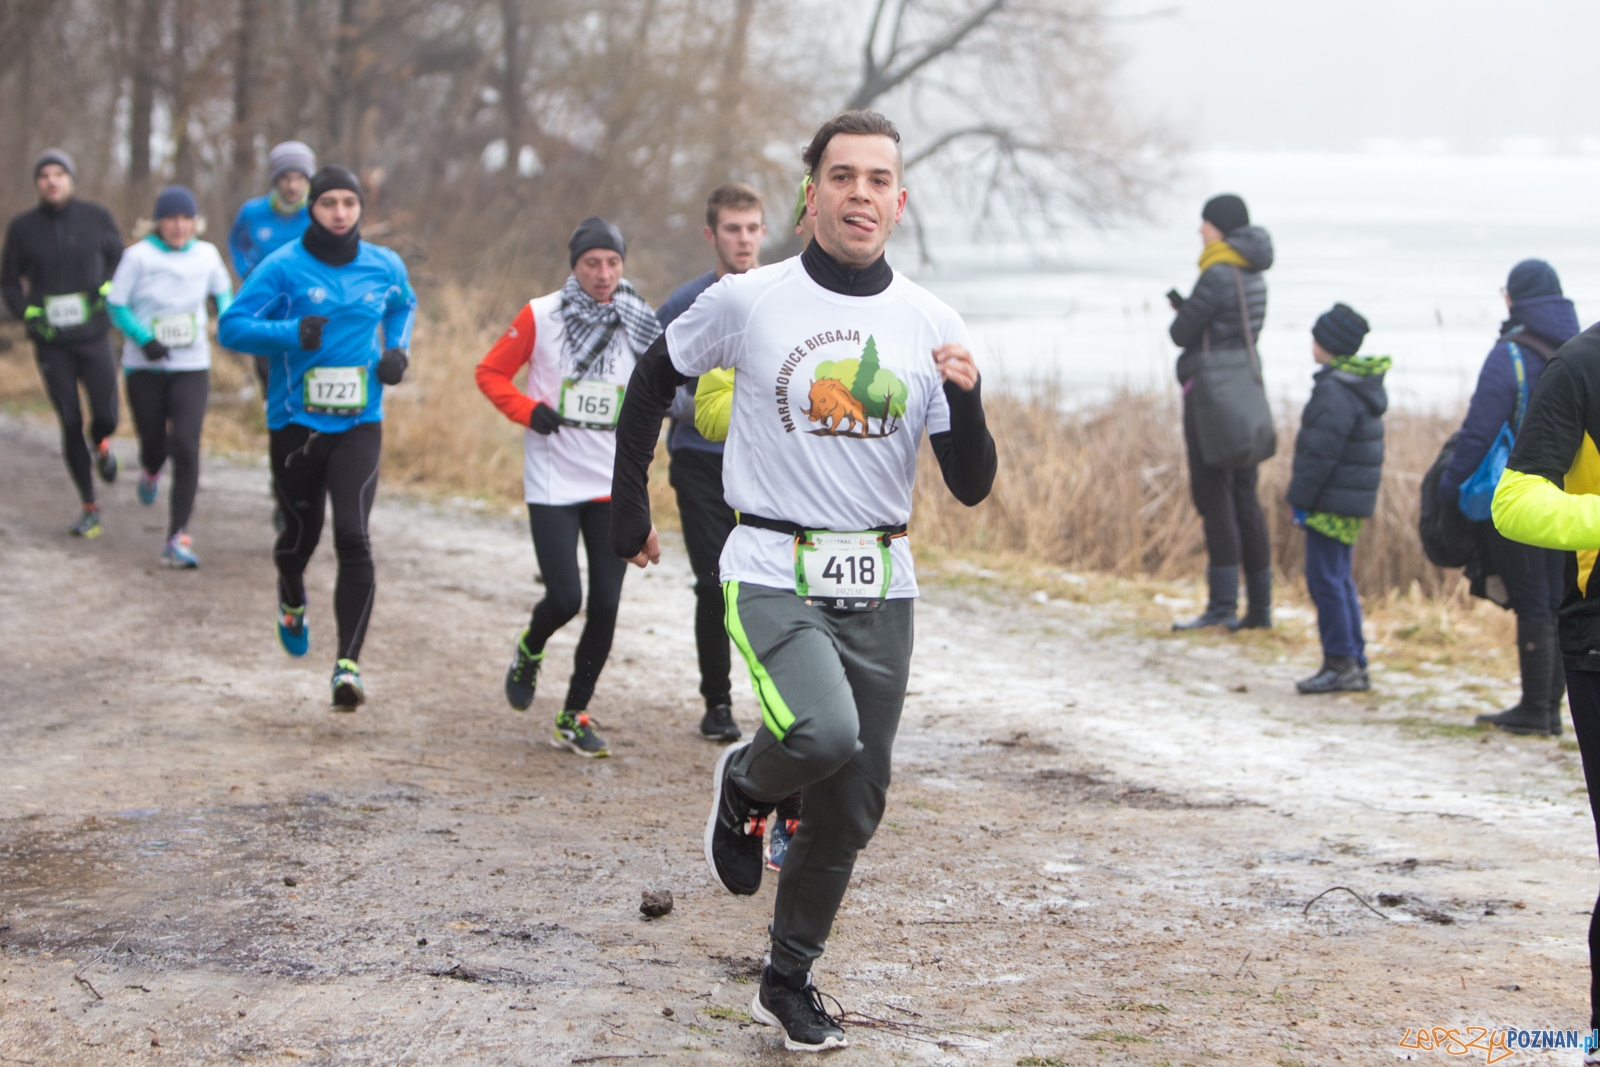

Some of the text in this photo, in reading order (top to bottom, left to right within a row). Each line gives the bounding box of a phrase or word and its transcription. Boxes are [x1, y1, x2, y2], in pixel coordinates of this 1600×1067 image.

[315, 382, 356, 399] 1727
[775, 329, 861, 434] NARAMOWICE BIEGAJĄ
[576, 393, 611, 416] 165
[821, 555, 875, 585] 418
[835, 587, 866, 596] PRZEMO
